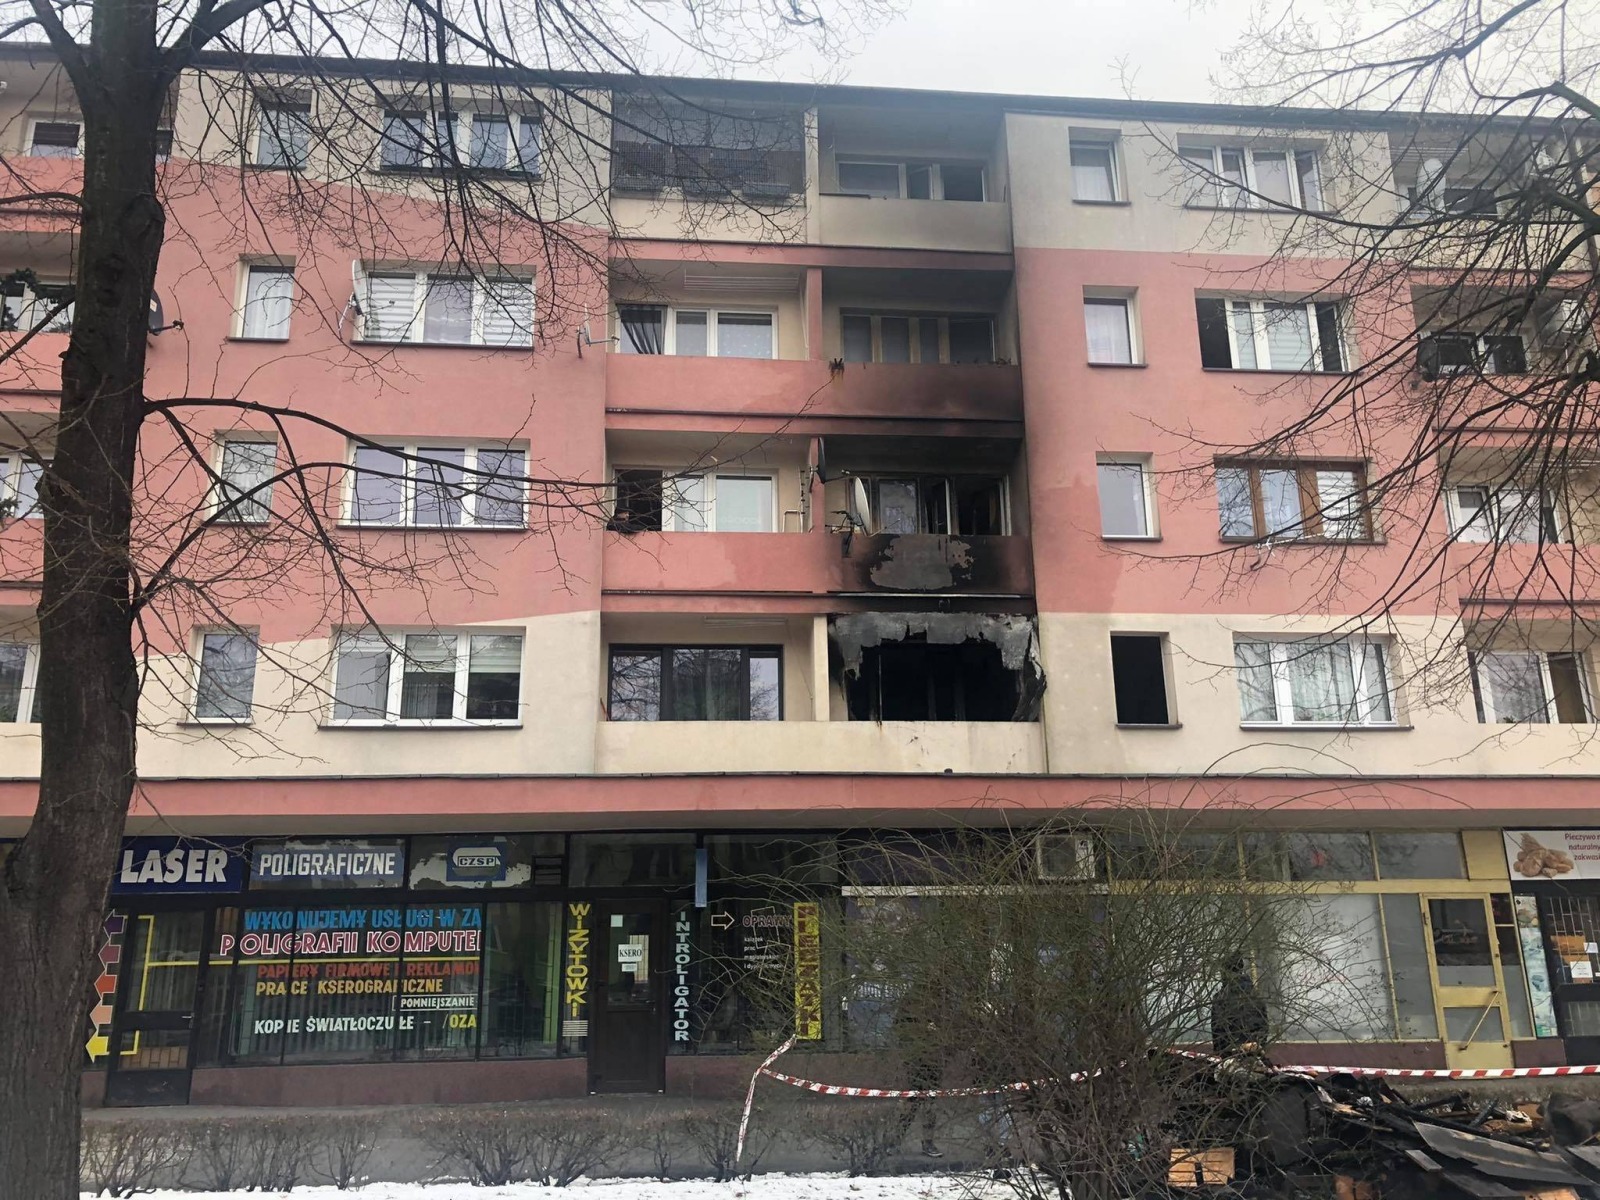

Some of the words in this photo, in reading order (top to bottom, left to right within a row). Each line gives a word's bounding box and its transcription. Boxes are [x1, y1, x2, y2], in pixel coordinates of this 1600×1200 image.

[120, 848, 228, 884] LASER
[259, 852, 396, 876] POLIGRAFICZNE
[459, 857, 494, 866] CZSP
[244, 909, 367, 931] WYKONUJEMY
[371, 908, 434, 928] USŁUGI
[438, 908, 457, 928] W
[742, 914, 792, 928] OPRAWY
[220, 931, 358, 955] POLIGRAFII
[619, 949, 642, 957] KSERO
[257, 963, 319, 978] PAPIERY
[325, 962, 390, 977] FIRMOWE
[674, 911, 690, 1042] INTROLIGATOR
[255, 980, 308, 996] PRACE
[400, 996, 475, 1009] POMNIEJSZANIE
[254, 1019, 300, 1034] KOPIE
[305, 1015, 414, 1033] ŚWIATŁOCZUŁE
